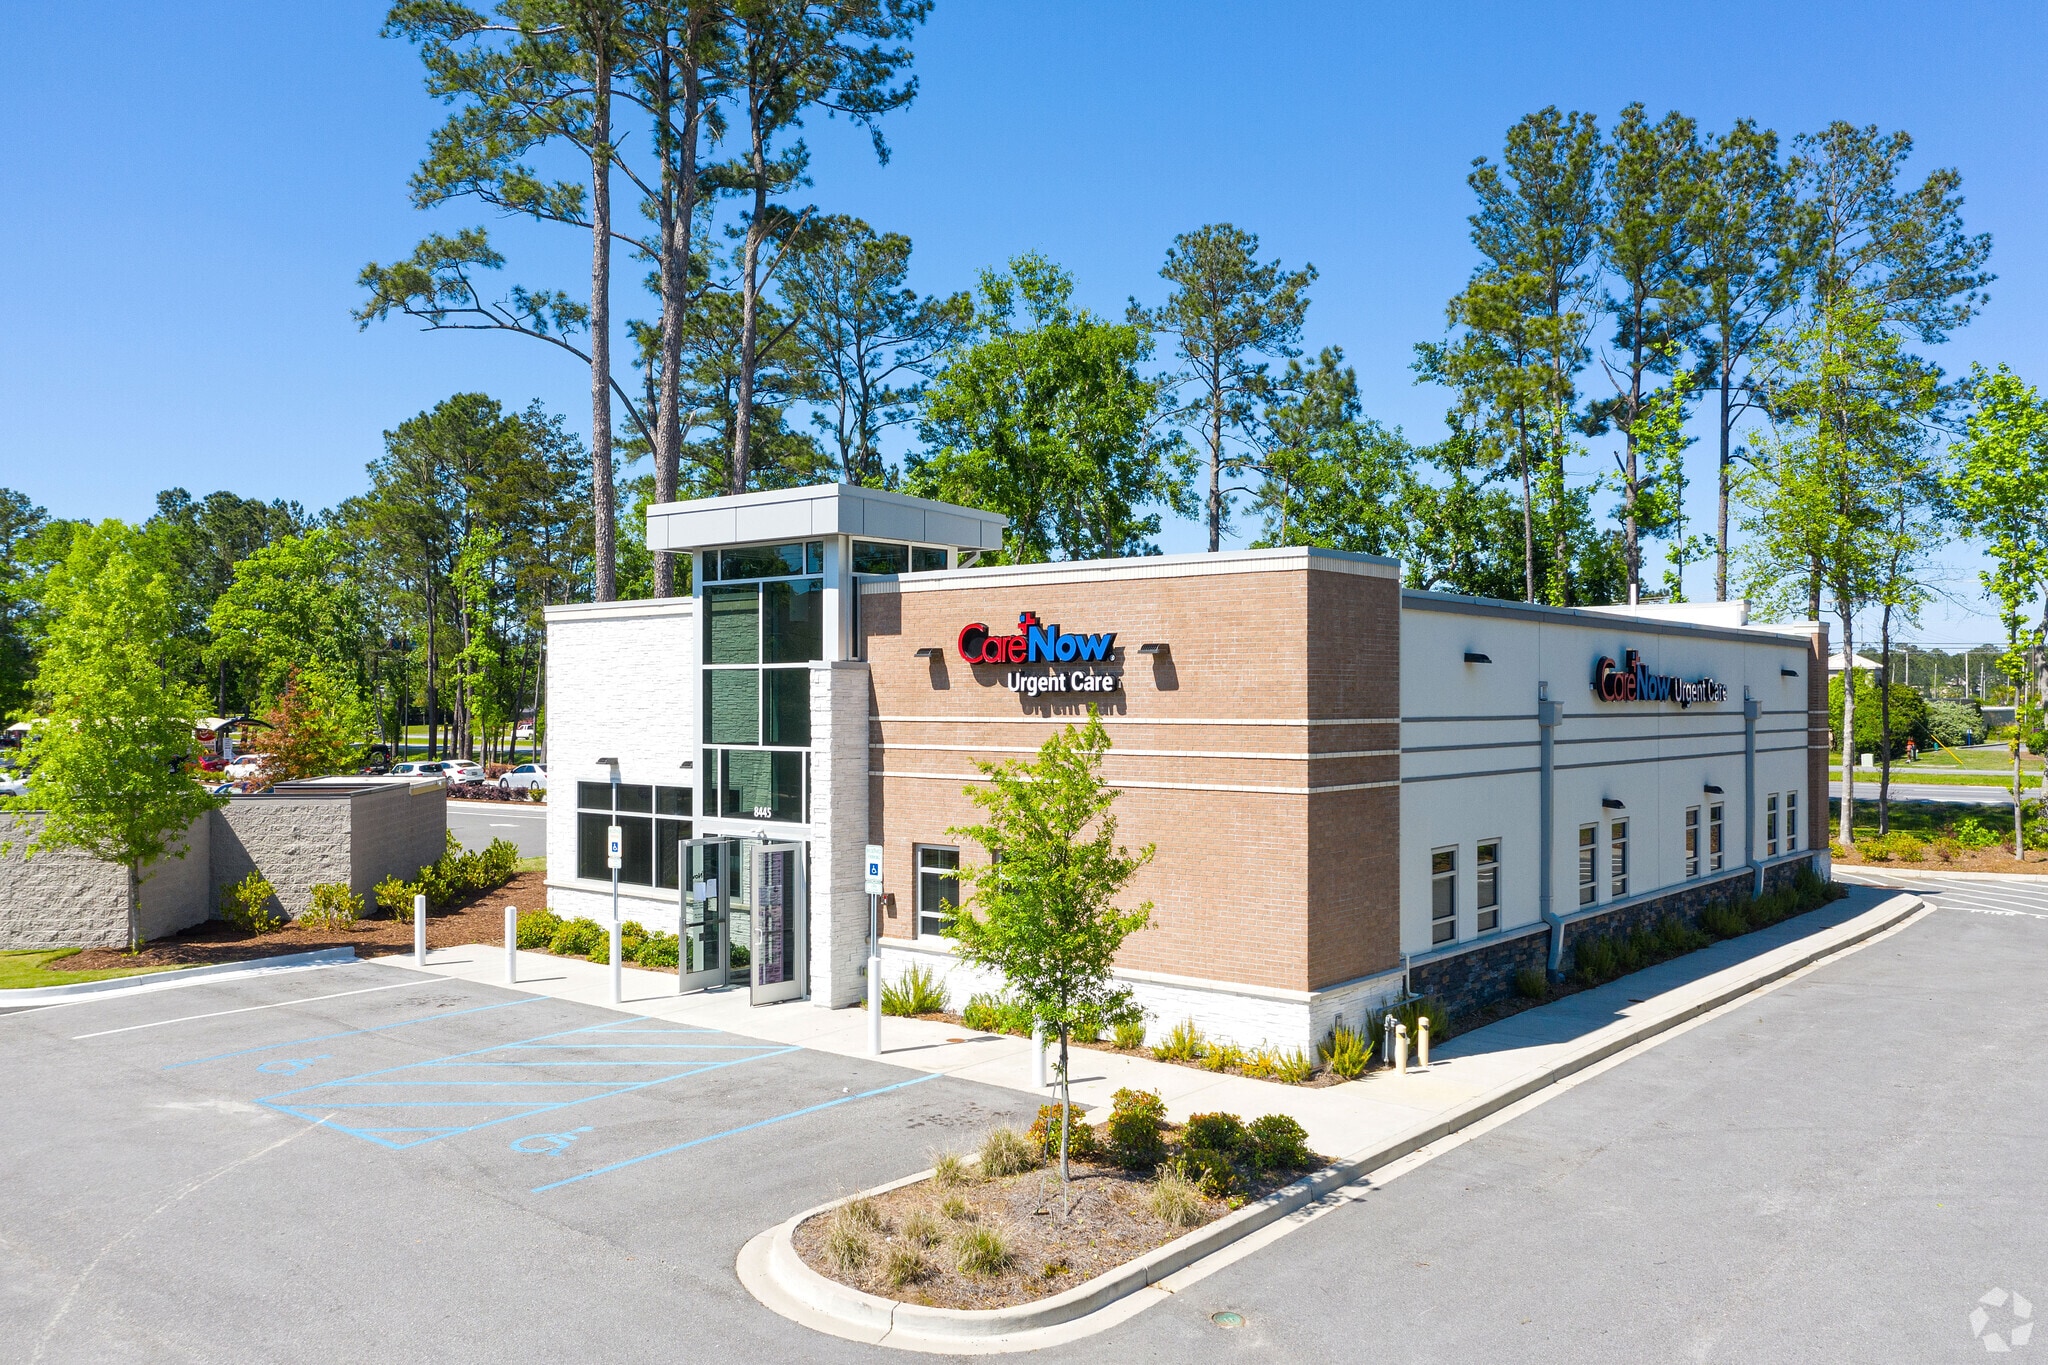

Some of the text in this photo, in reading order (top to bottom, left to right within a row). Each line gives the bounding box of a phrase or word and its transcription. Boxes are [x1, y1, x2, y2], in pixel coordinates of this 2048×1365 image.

[958, 622, 1112, 664] CareNow
[1007, 671, 1114, 697] Urgent Care
[1600, 656, 1728, 709] CareNow Urgent Care
[753, 806, 772, 819] 8445
